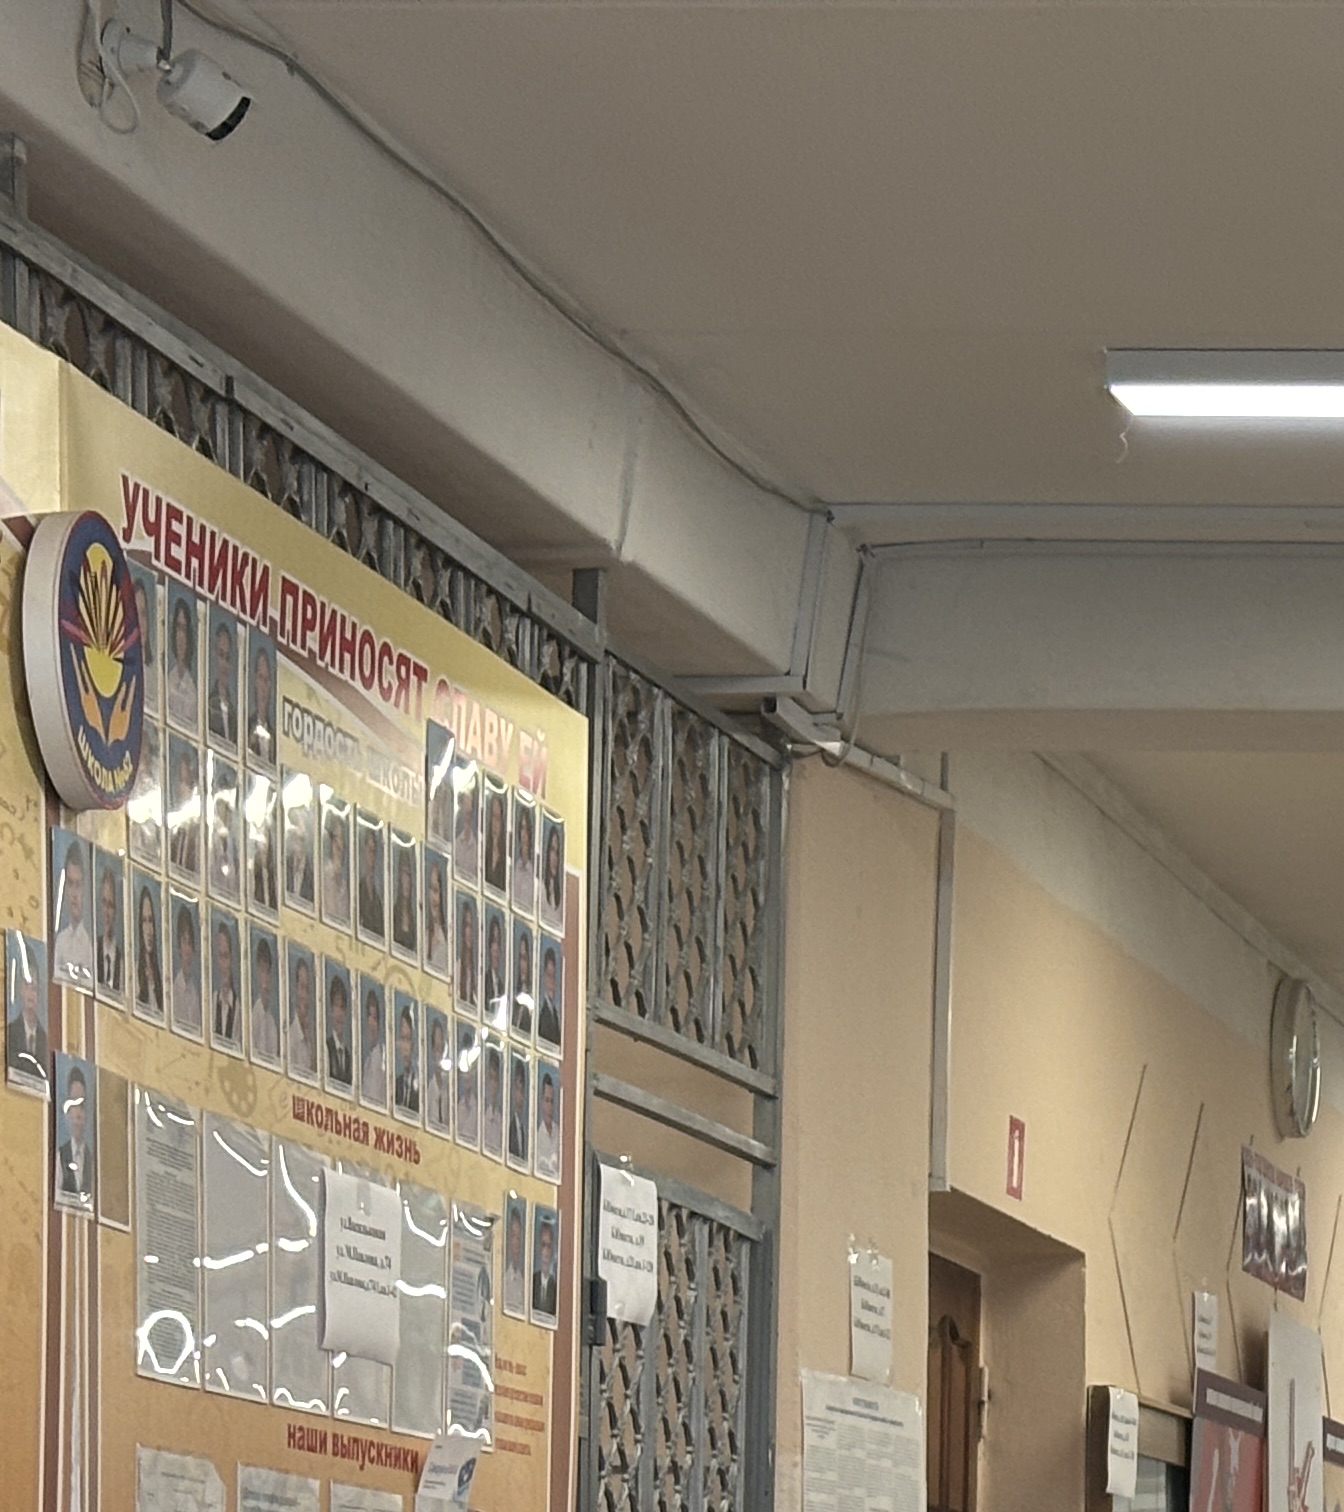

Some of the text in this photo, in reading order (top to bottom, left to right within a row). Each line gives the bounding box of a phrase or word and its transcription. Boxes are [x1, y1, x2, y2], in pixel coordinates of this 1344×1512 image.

[121, 474, 270, 630] УЧЕНИКИ
[279, 574, 428, 718] ПРИНОСЯТ
[292, 1094, 421, 1165] школьная жизнь
[287, 1423, 419, 1473] наши выпускники
